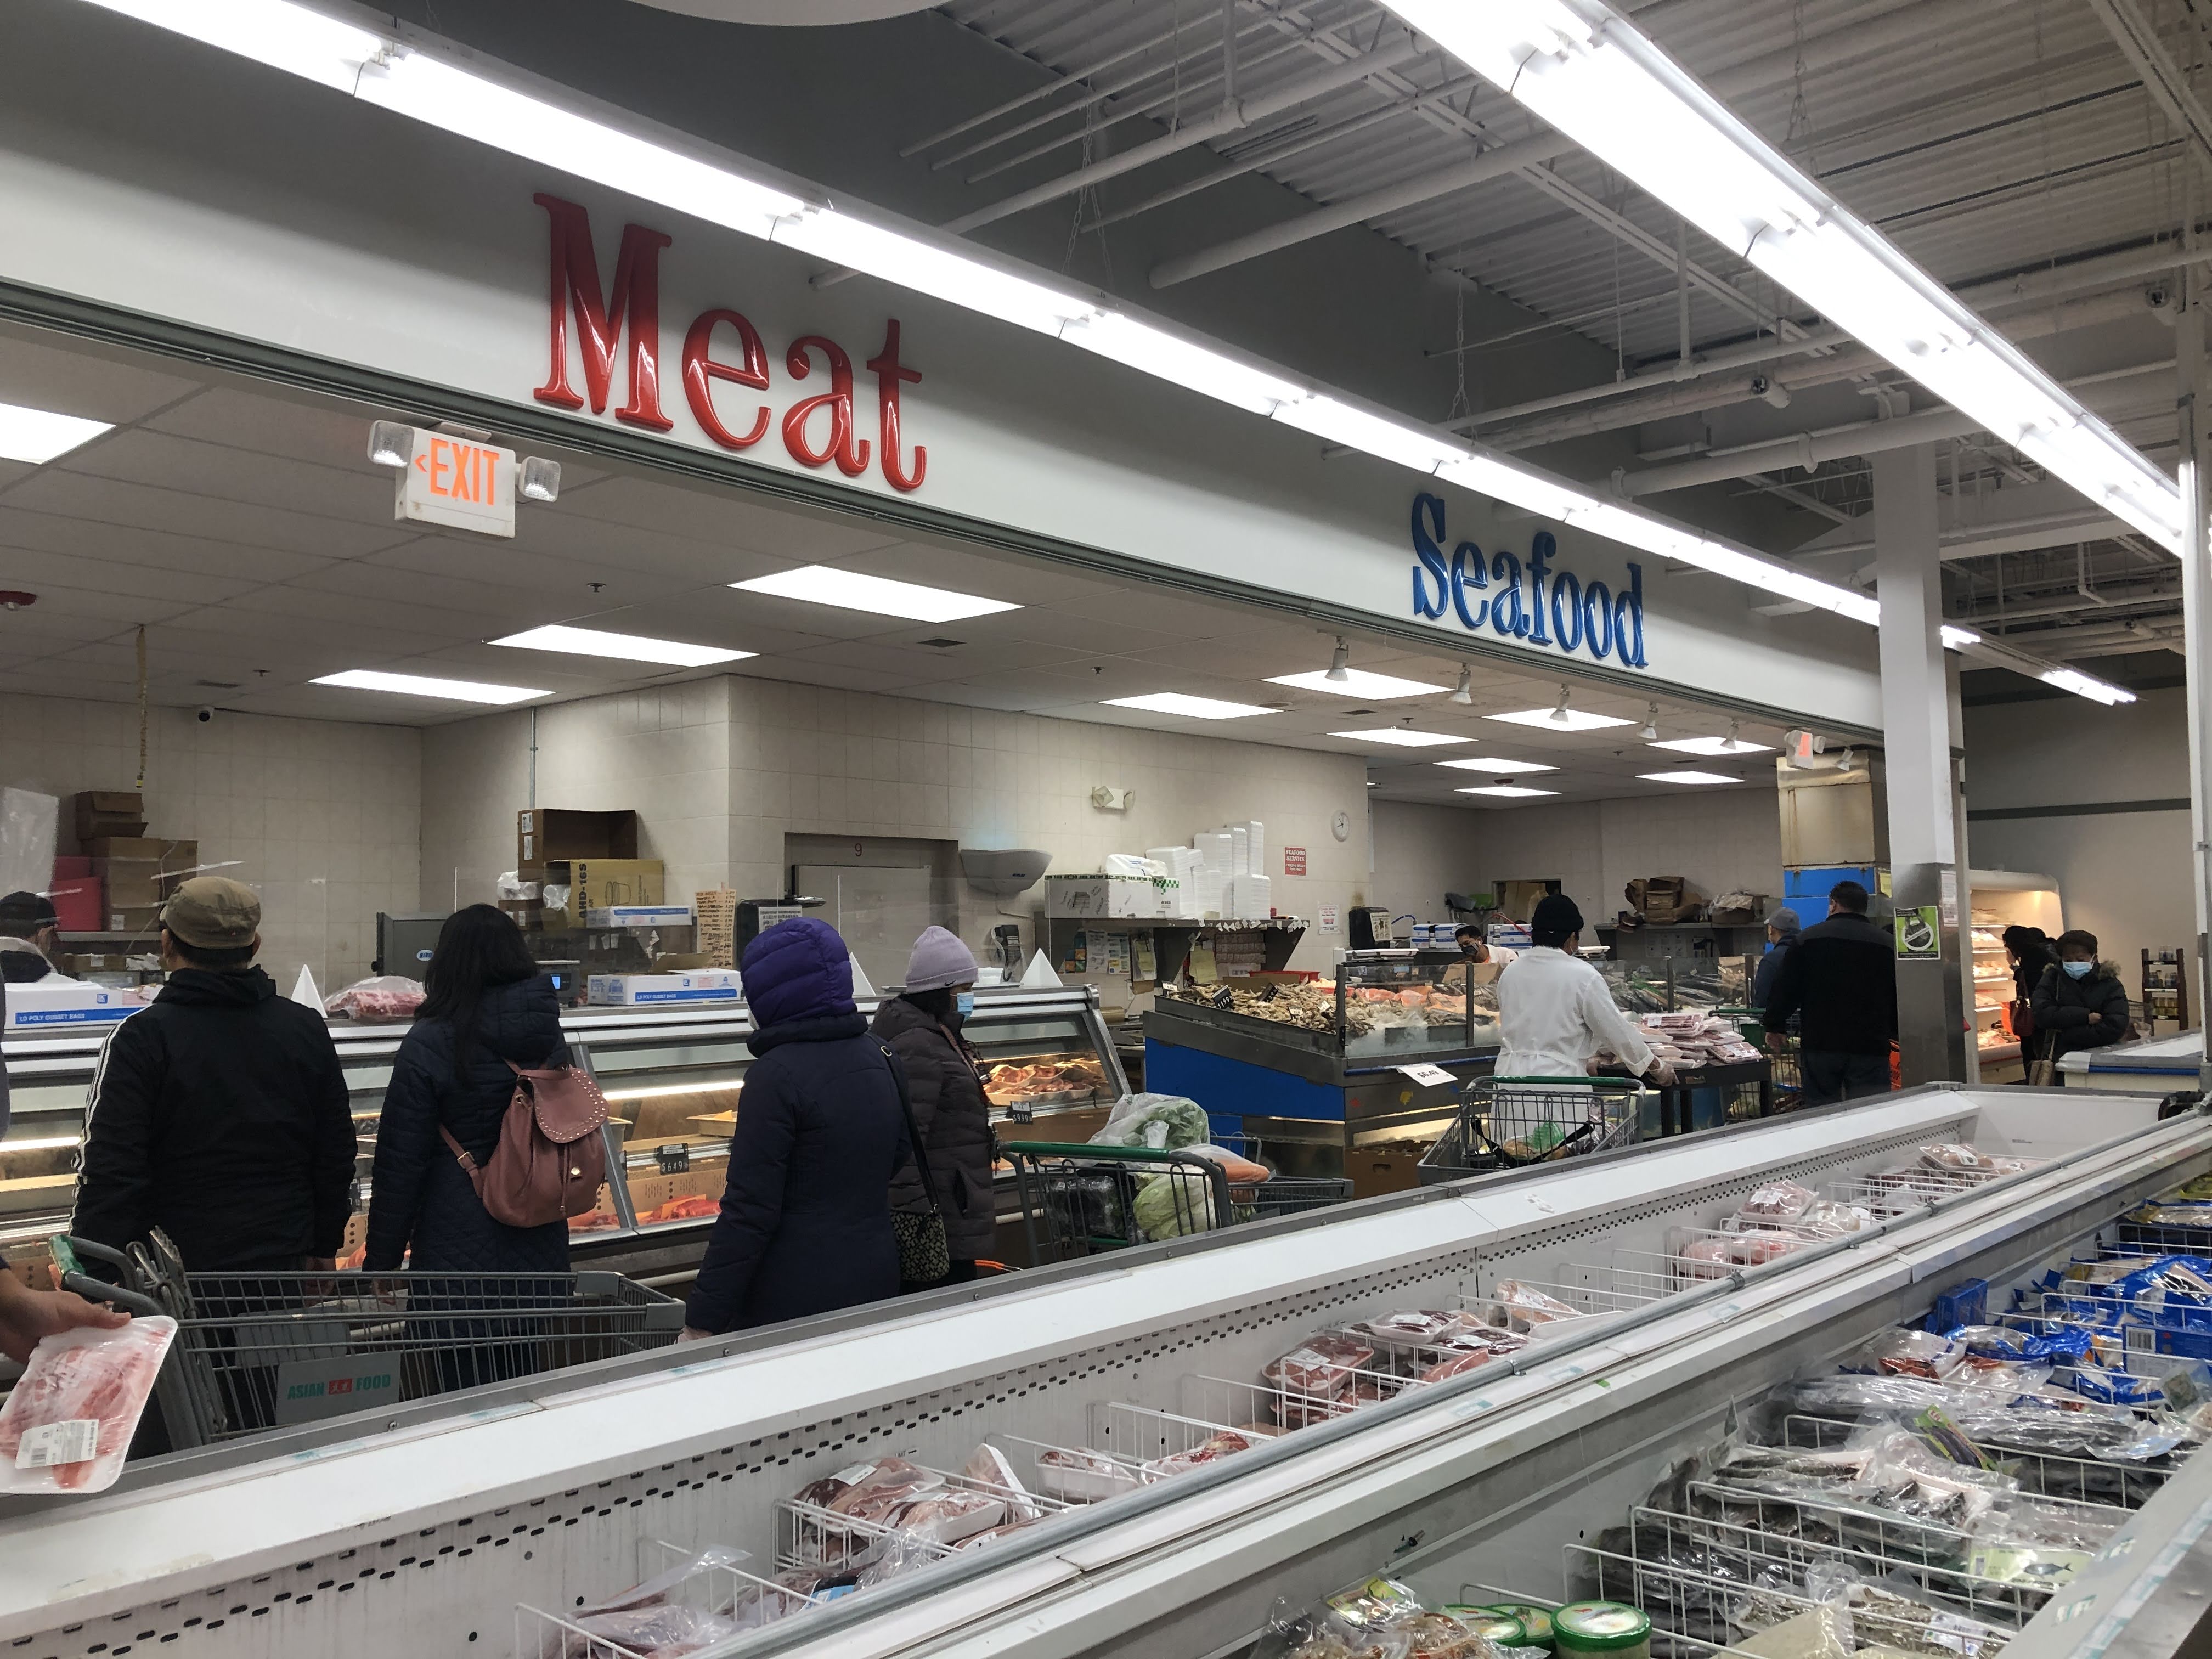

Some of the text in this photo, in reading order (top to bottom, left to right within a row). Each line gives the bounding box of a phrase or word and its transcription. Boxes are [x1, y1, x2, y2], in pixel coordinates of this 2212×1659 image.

[533, 193, 927, 491] Meat
[430, 438, 500, 505] EXIT
[1412, 493, 1649, 668] Seafood
[855, 843, 862, 857] 9
[579, 863, 587, 918] AHD-16S
[1417, 1070, 1440, 1078] $6.49
[287, 1382, 325, 1400] ASIAN
[355, 1374, 391, 1391] FOOD
